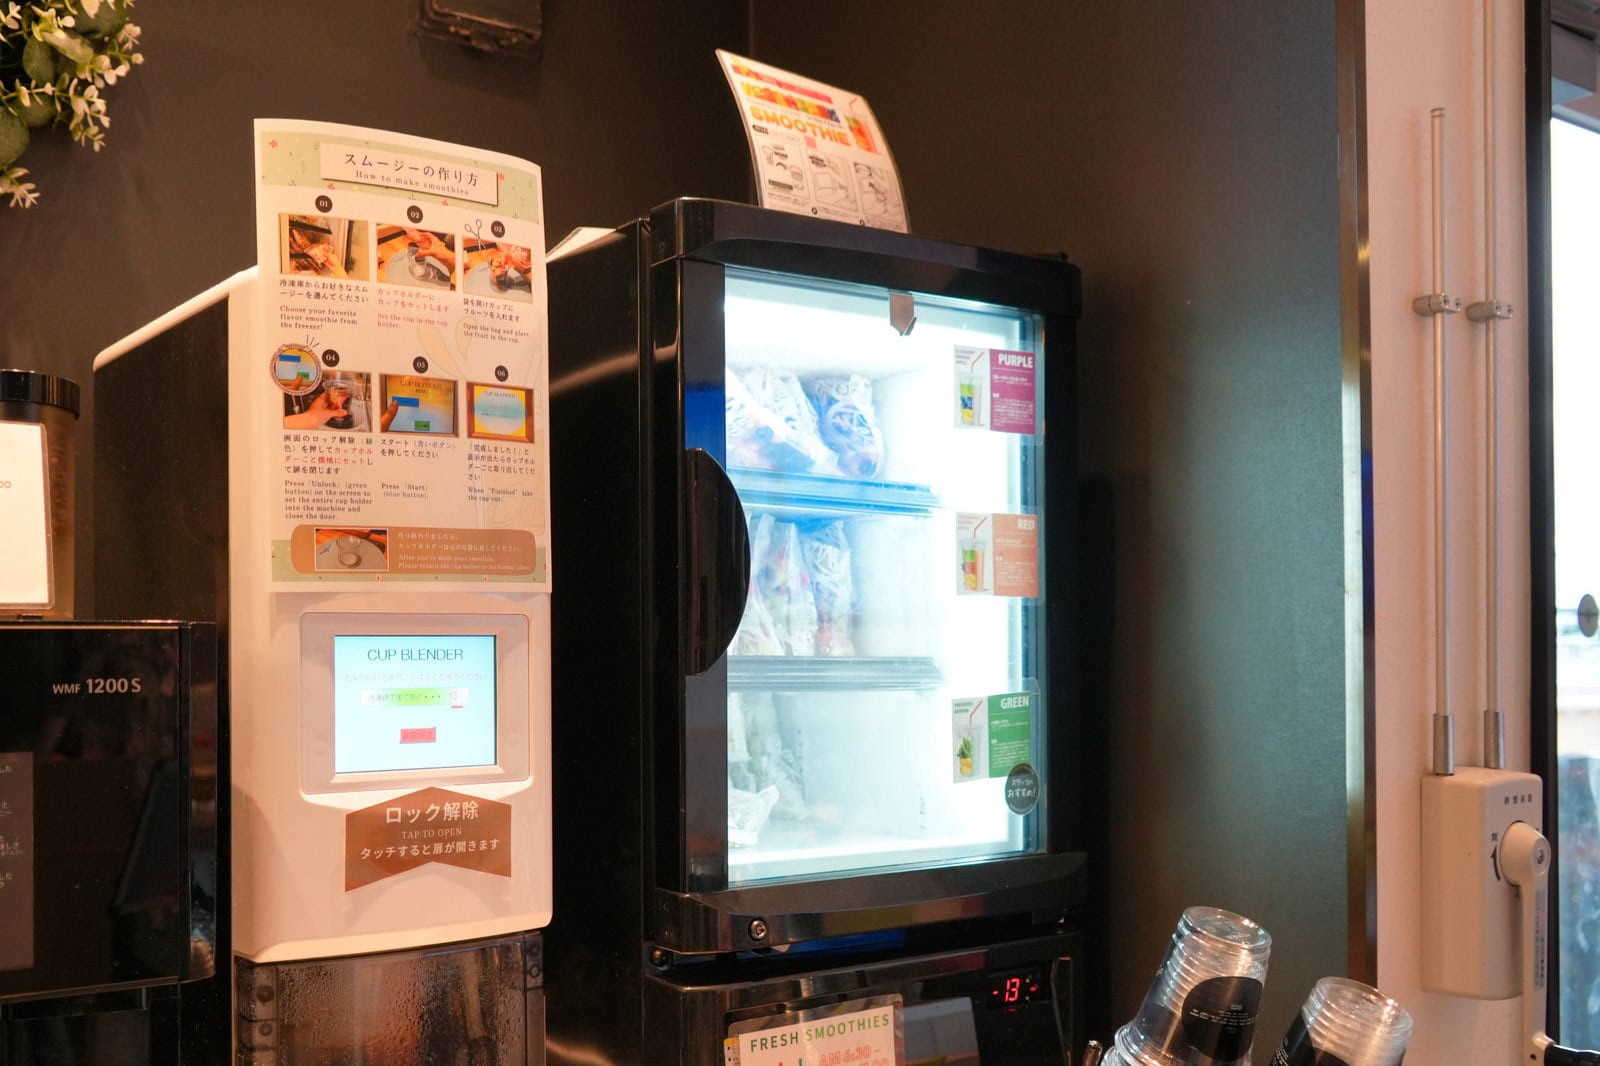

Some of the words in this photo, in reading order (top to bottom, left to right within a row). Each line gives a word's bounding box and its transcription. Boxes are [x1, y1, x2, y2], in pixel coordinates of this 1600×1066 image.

[750, 106, 851, 147] SMOOTHIE
[344, 153, 478, 187] スムージーの作り方
[355, 171, 377, 180] How
[381, 175, 391, 183] to
[395, 177, 419, 188] make
[423, 182, 469, 196] smoothies
[319, 200, 329, 208] 01
[280, 279, 368, 293] 冷凍庫からお好きなスム
[280, 291, 369, 303] ージーを選んでください
[378, 288, 435, 300] カップホルダーに
[378, 299, 448, 312] カップをセットします
[305, 315, 338, 324] smoothie
[328, 309, 357, 317] favorite
[464, 308, 520, 322] フルーツを入れます
[490, 326, 501, 334] bag
[998, 354, 1034, 368] PURPLE
[381, 449, 439, 458] を押してください
[367, 649, 396, 661] CUP
[400, 649, 463, 661] BLENDER
[52, 683, 81, 694] WMF
[86, 678, 128, 694] 1200
[131, 678, 142, 693] S
[1001, 695, 1030, 709] GREEN
[386, 800, 479, 824] ロック解除
[402, 830, 420, 840] TAP
[423, 829, 435, 838] TO
[437, 827, 463, 837] OPEN
[361, 838, 500, 860] タッチすると扉が開きます
[751, 1031, 799, 1053] FRESH
[805, 1013, 889, 1042] SMOOTHIES
